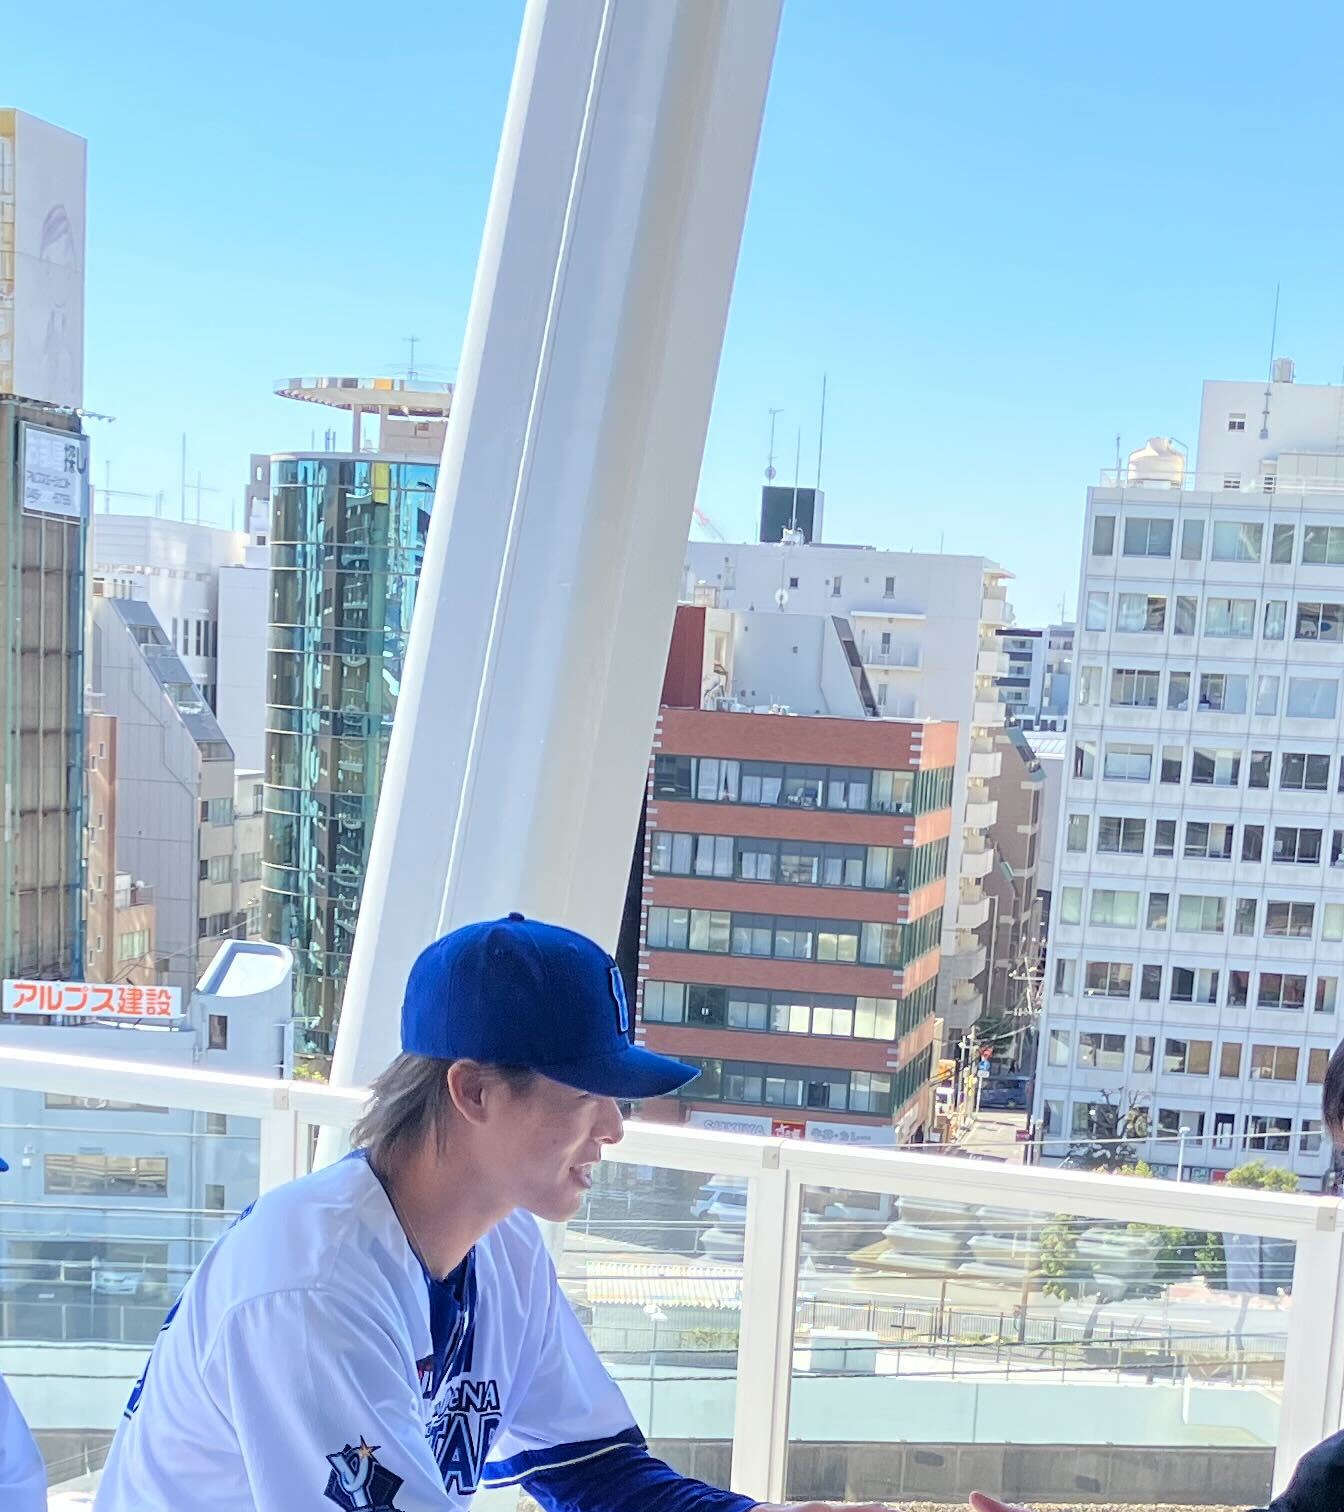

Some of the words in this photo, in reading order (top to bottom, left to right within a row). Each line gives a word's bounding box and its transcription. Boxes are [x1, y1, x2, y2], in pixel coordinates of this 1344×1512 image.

[12, 983, 173, 1017] アルプス建設
